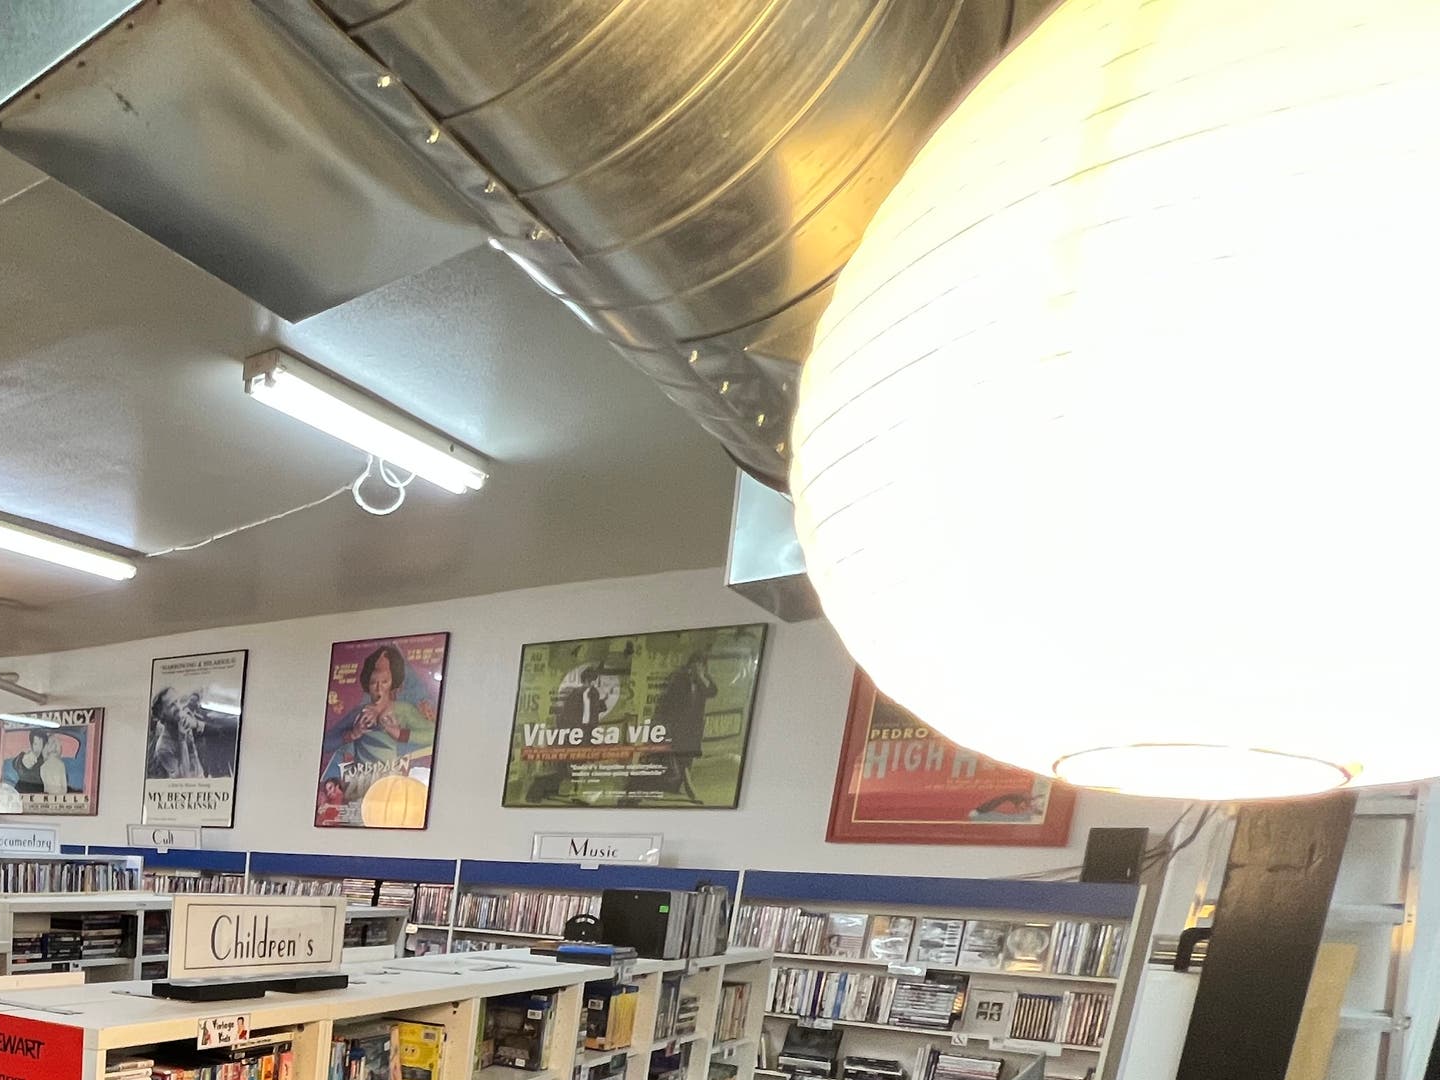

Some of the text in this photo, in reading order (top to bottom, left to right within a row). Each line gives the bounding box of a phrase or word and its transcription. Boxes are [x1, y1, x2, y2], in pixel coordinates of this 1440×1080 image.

[523, 723, 584, 746] Vivre
[590, 725, 620, 745] sa
[870, 728, 929, 740] PEDRO
[862, 740, 945, 779] HIGH
[148, 792, 230, 802] MY BEST FIEND
[157, 801, 217, 810] KLAUS KINSKI
[152, 829, 174, 845] Cult
[568, 838, 619, 858] Music
[210, 914, 315, 961] Children's
